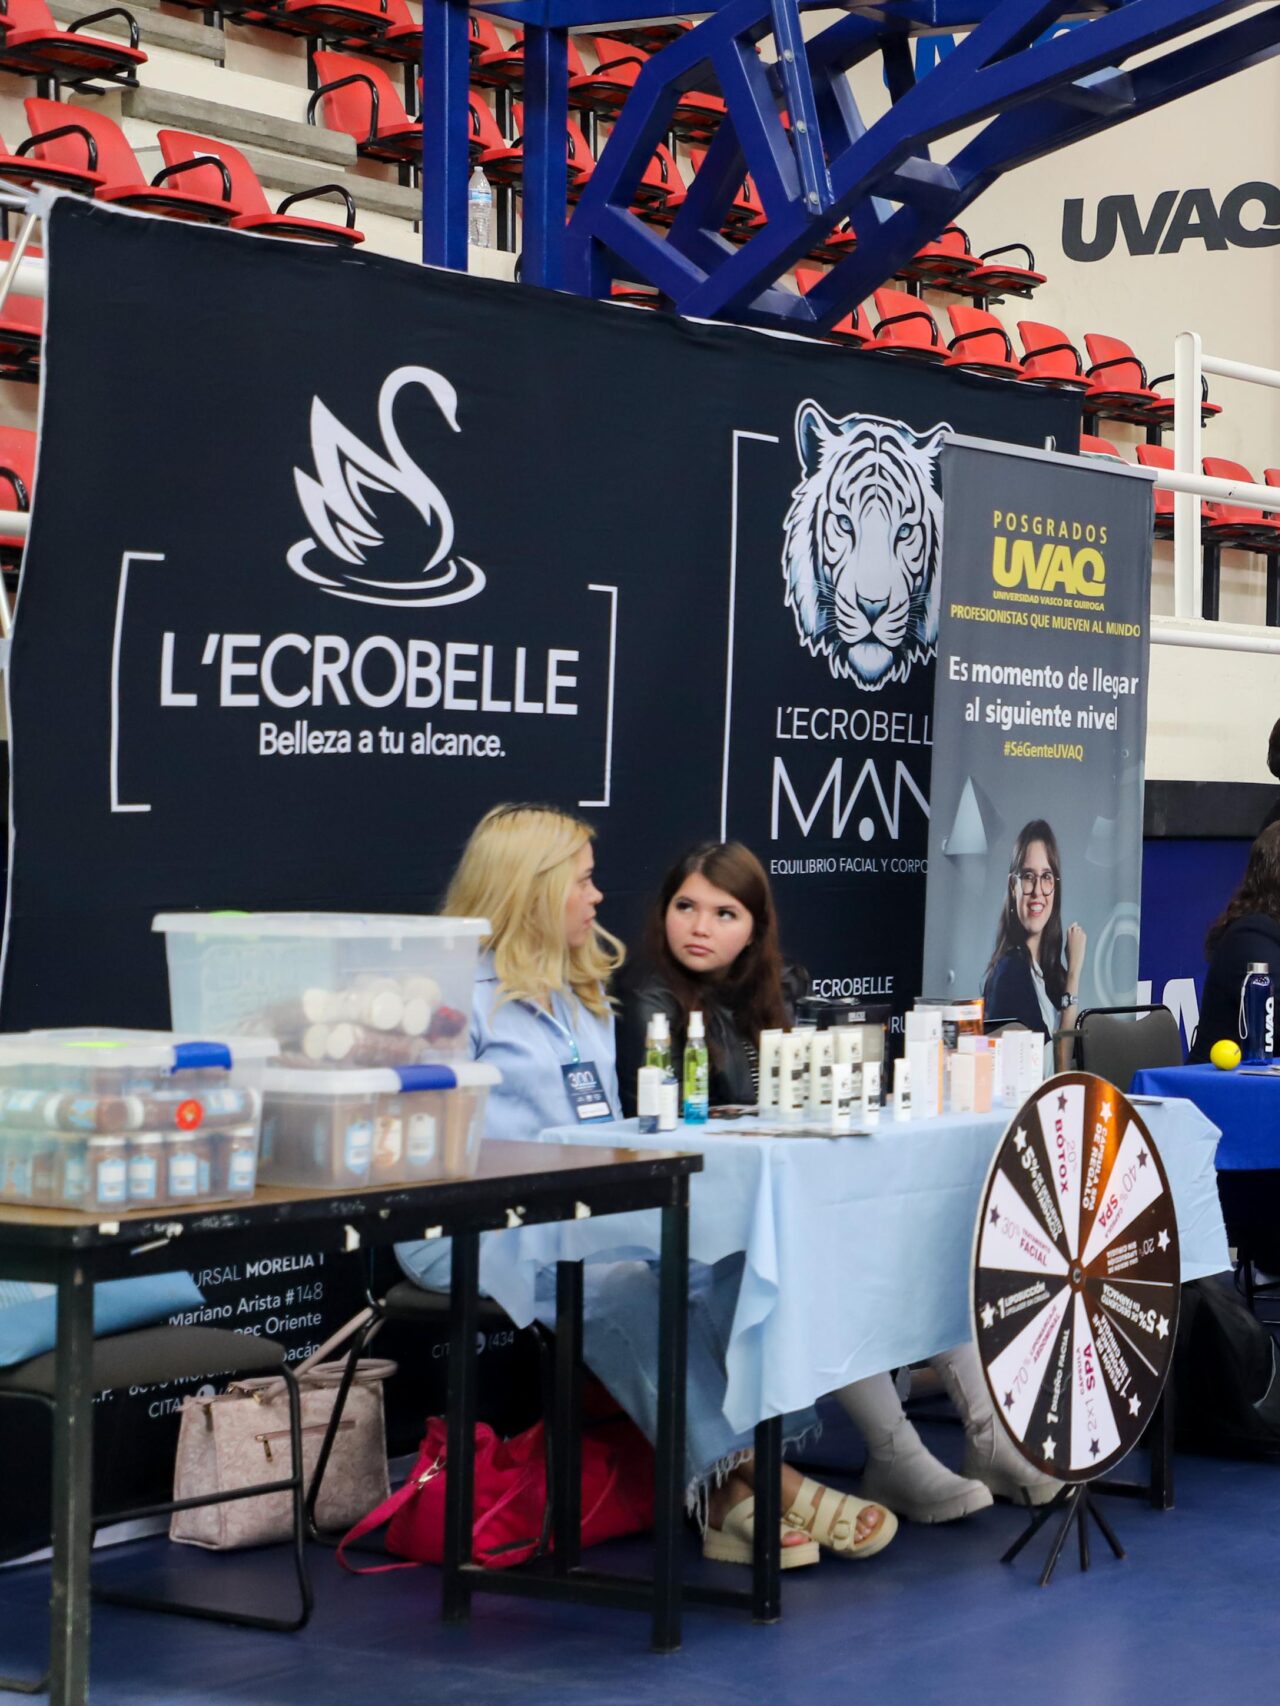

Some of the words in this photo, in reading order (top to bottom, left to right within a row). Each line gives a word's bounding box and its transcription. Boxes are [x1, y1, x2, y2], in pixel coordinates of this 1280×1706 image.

[994, 510, 1108, 545] POSGRADOS
[992, 536, 1106, 597] UVAQ
[993, 590, 1040, 606] UNIVERSIDAD
[1040, 596, 1062, 607] VASCO
[1064, 598, 1073, 608] DE
[1074, 600, 1105, 611] QUIROGA
[951, 604, 1029, 626] PROFESIONISTAS
[1030, 613, 1050, 629] QUE
[1052, 616, 1090, 633] MUEVEN
[1092, 621, 1104, 634] AL
[1106, 622, 1141, 637] MUNDO
[949, 655, 968, 682] Es
[972, 663, 1064, 689] momento
[1068, 666, 1088, 691] de
[1092, 667, 1140, 699] llegar
[965, 697, 980, 722] al
[986, 698, 1073, 731] siguiente
[1077, 704, 1118, 731] nivel
[259, 720, 351, 755] Belleza
[358, 728, 373, 753] a
[379, 726, 405, 754] tu
[411, 722, 506, 757] alcance.
[1004, 740, 1083, 762] #SéGenteUVAQ
[770, 857, 837, 875] EQUILIBRIO
[839, 857, 878, 873] FACIAL
[881, 858, 888, 873] Y
[1265, 996, 1274, 1052] UVAQ
[1022, 1146, 1039, 1179] 5%
[1098, 1194, 1119, 1227] SPA
[246, 1253, 315, 1279] MORELIA
[1020, 1237, 1047, 1267] FACIAL
[236, 1295, 282, 1315] Arista
[1138, 1309, 1157, 1334] 5%
[265, 1312, 323, 1335] Oriente
[1083, 1343, 1096, 1391] SPA
